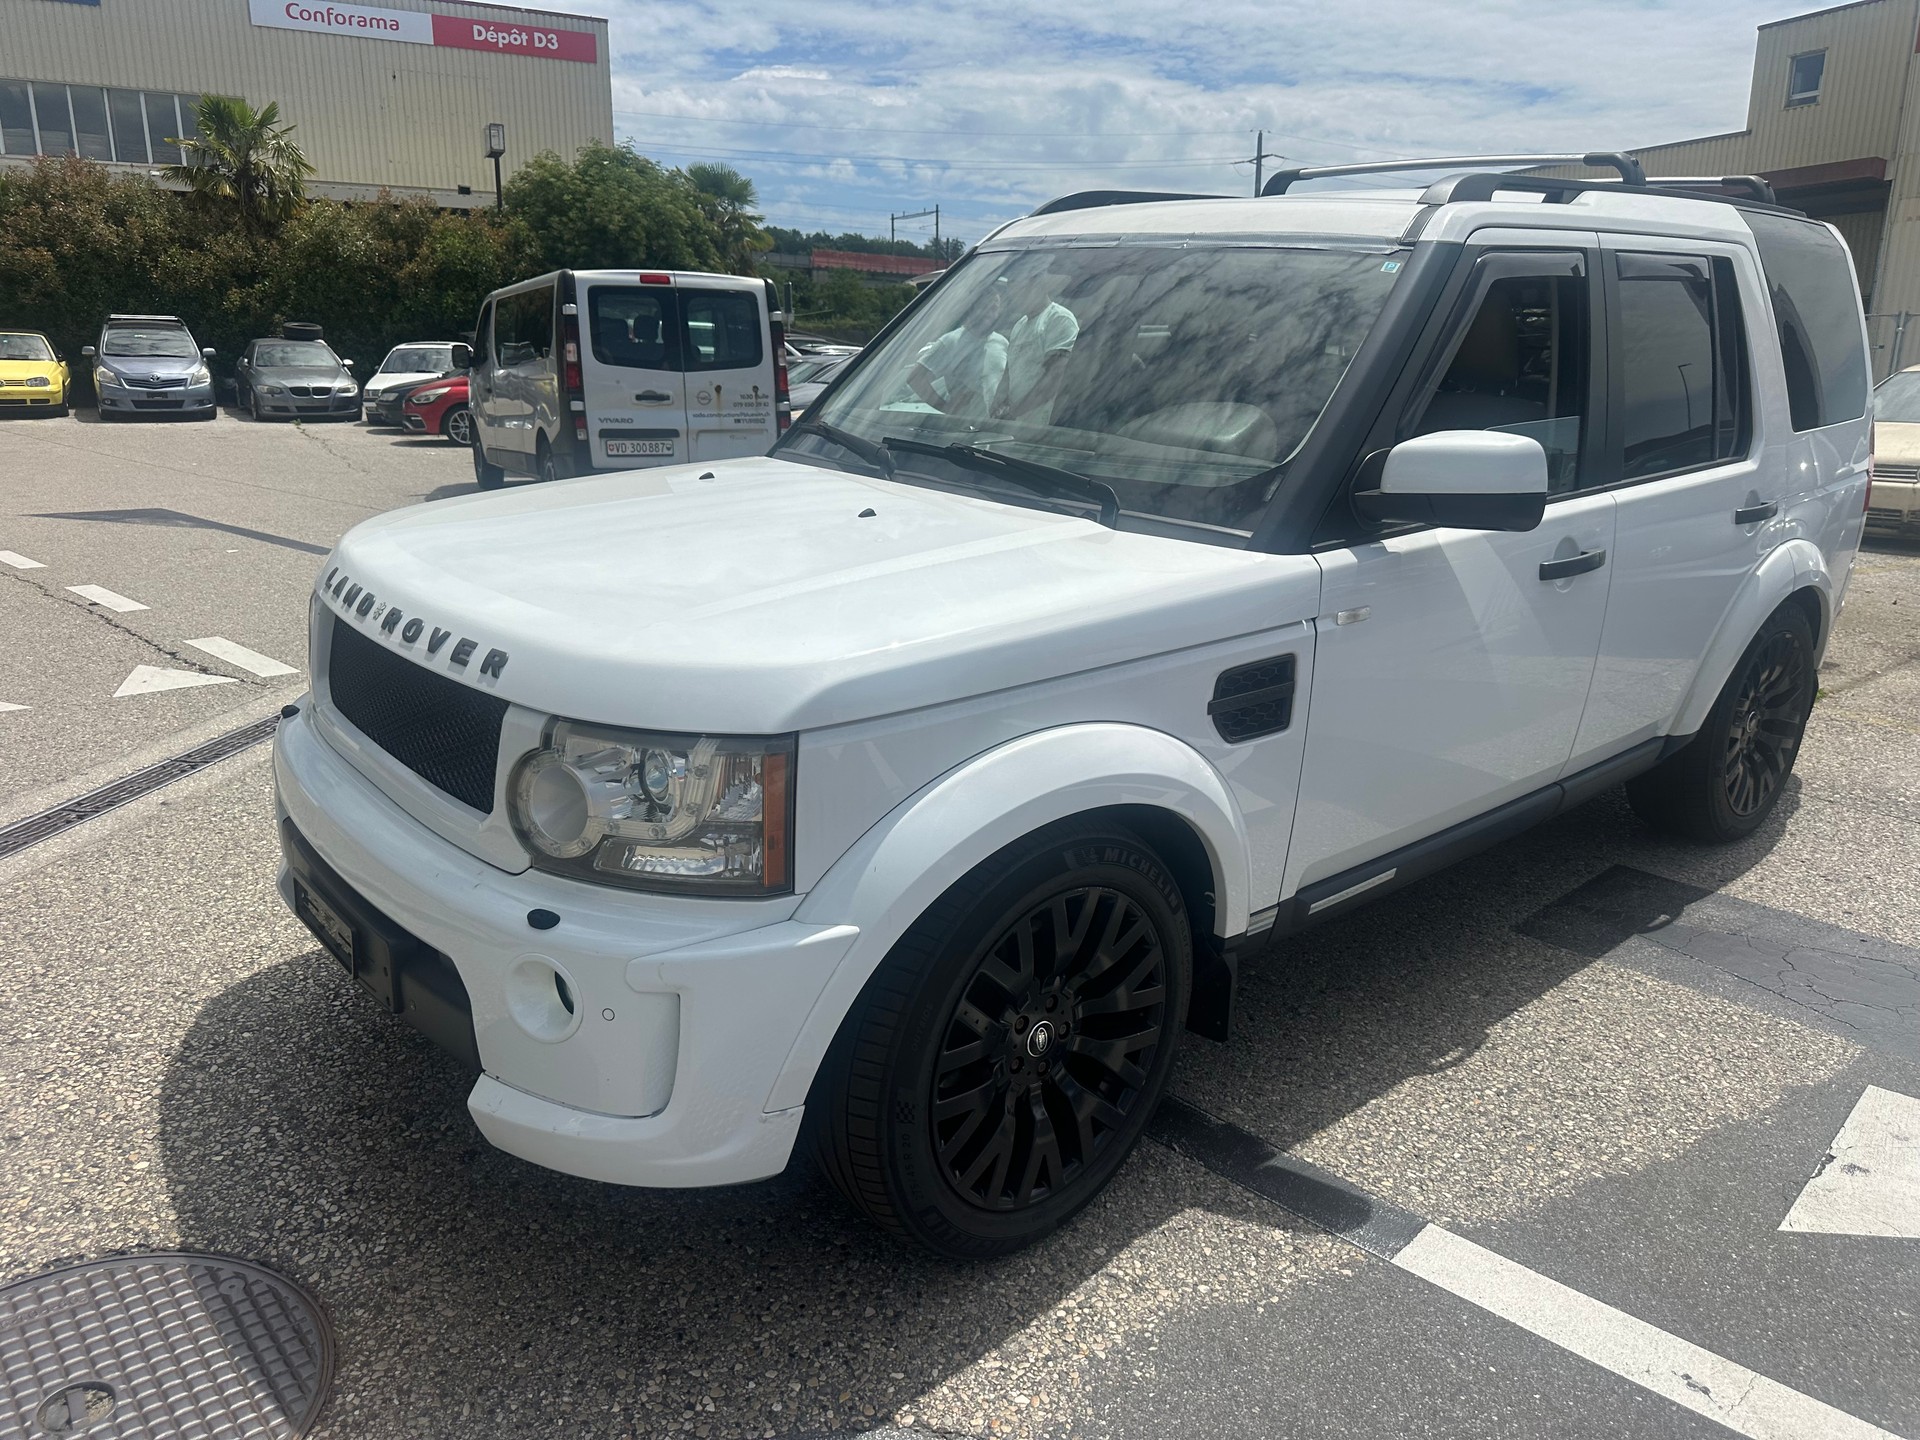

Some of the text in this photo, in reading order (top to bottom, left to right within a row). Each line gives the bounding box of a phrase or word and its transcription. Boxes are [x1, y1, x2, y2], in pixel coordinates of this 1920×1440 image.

[285, 1, 400, 32] Conforama
[472, 24, 558, 50] Dépôt D3
[325, 566, 510, 679] LAND ROVER
[1103, 847, 1179, 909] MICHELIN
